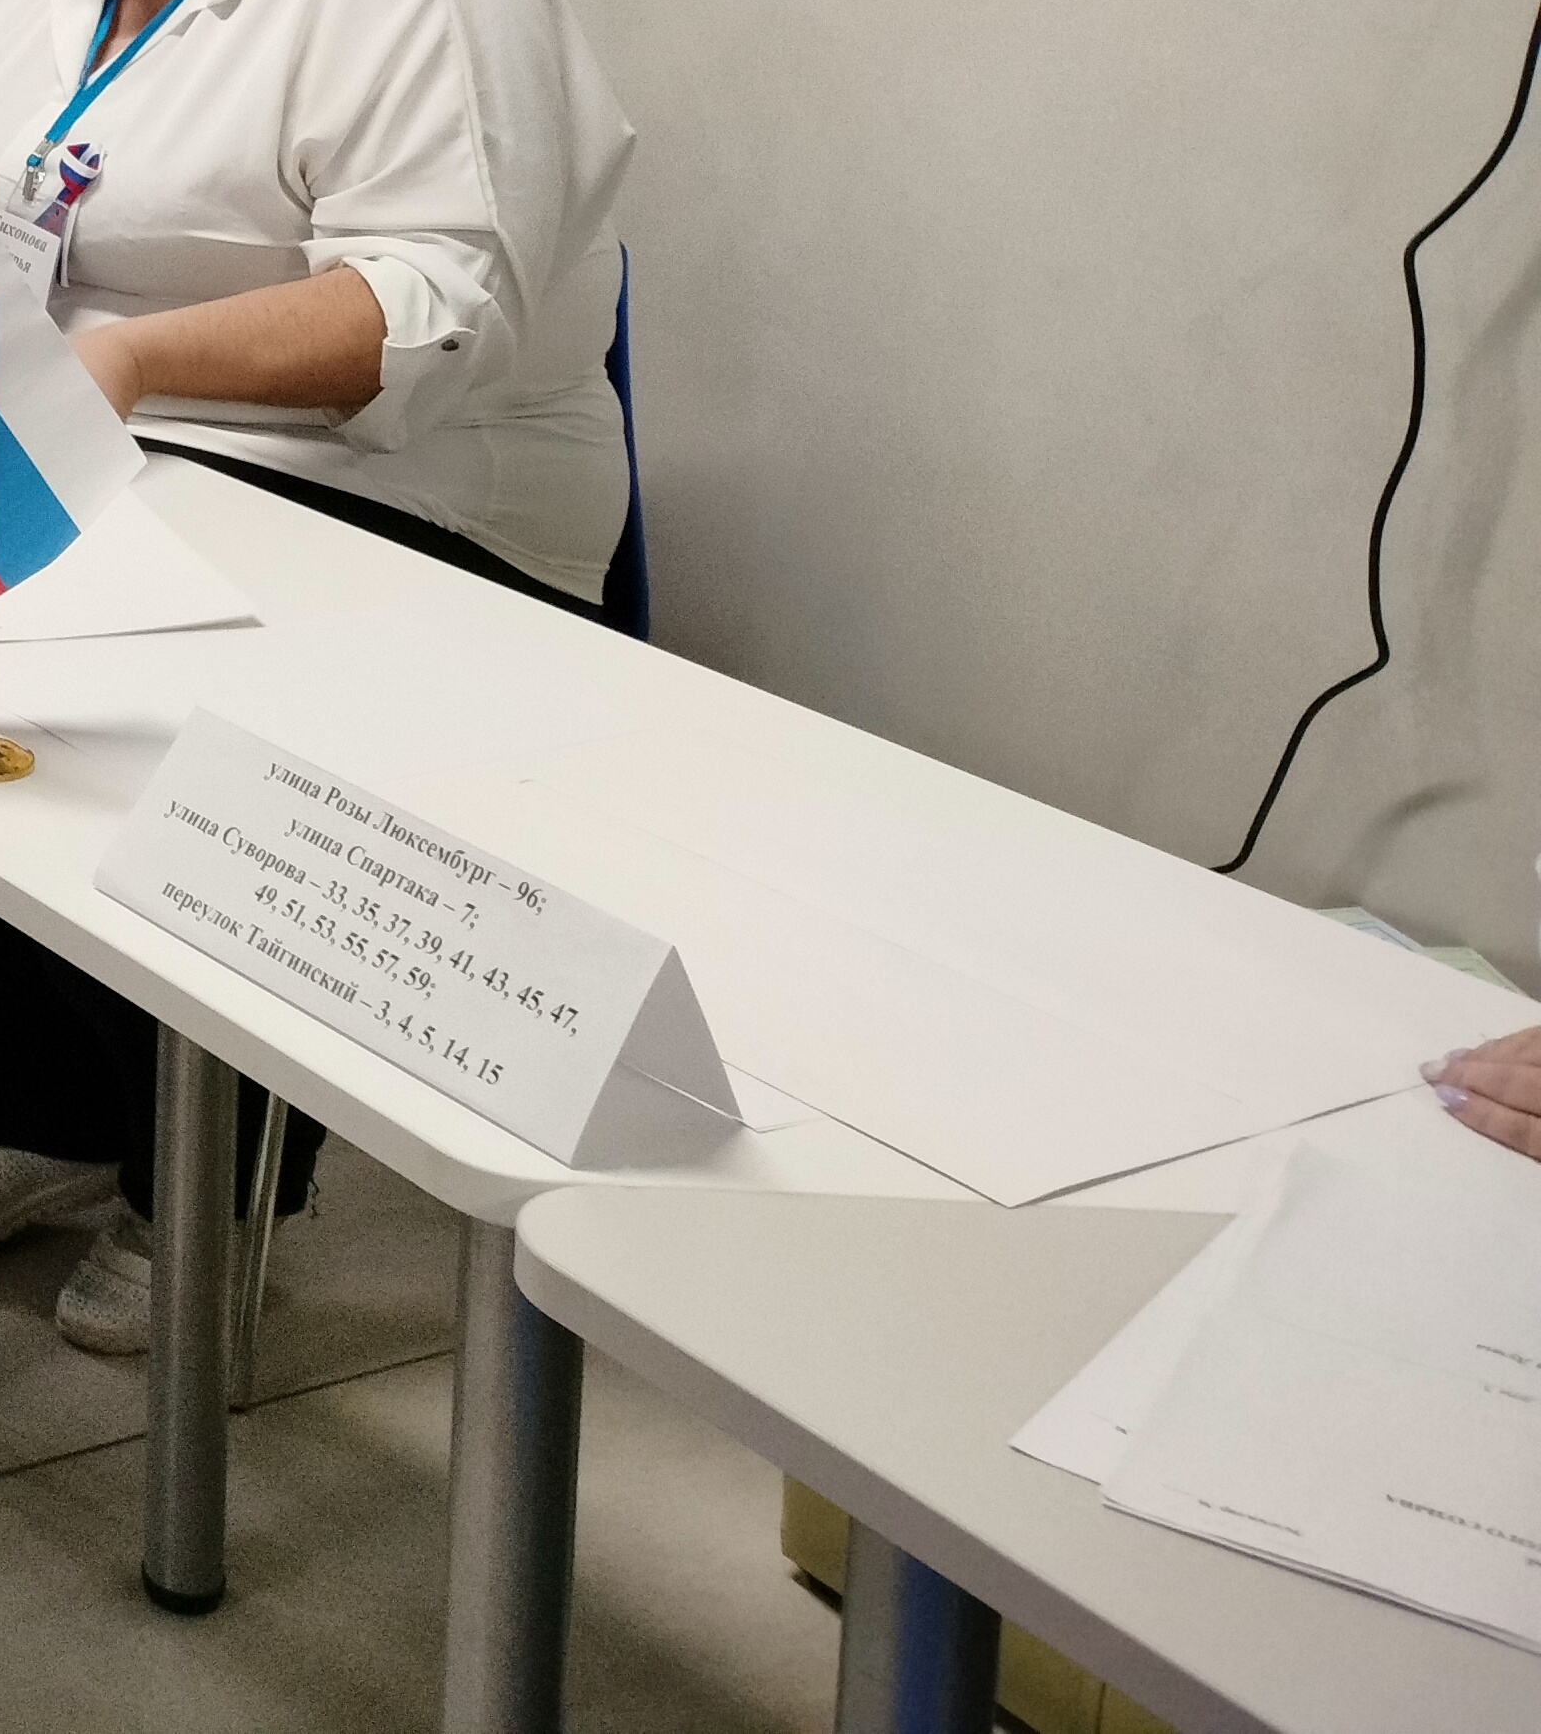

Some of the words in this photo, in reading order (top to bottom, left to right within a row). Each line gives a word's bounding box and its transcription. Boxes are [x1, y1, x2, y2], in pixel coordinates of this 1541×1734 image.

[263, 762, 322, 799] улица
[323, 786, 373, 825] Розы
[372, 815, 497, 885] Люксембург
[515, 882, 547, 917] 96;
[285, 818, 343, 857] улица
[346, 845, 440, 908] Спартака
[460, 902, 480, 932] 7;
[161, 882, 242, 937] переулок
[246, 923, 359, 1004] Тайгинский
[373, 1000, 391, 1030] 3,
[397, 1014, 414, 1043] 4,
[418, 1025, 437, 1056] 5,
[442, 1038, 470, 1075] 14,
[476, 1058, 505, 1085] 15
[163, 800, 220, 838] улица
[222, 826, 307, 885] Суворова
[321, 880, 348, 913] 33,
[351, 896, 381, 930] 35,
[382, 913, 412, 947] 37,
[413, 930, 443, 965] 39,
[449, 949, 475, 984] 41,
[482, 967, 510, 1002] 43,
[516, 985, 545, 1020] 45,
[549, 1003, 579, 1040] 47,
[254, 884, 278, 915] 49,
[281, 898, 306, 931] 51,
[310, 914, 337, 948] 53,
[340, 931, 369, 965] 55,
[371, 948, 400, 983] 57,
[402, 966, 436, 1002] 59;
